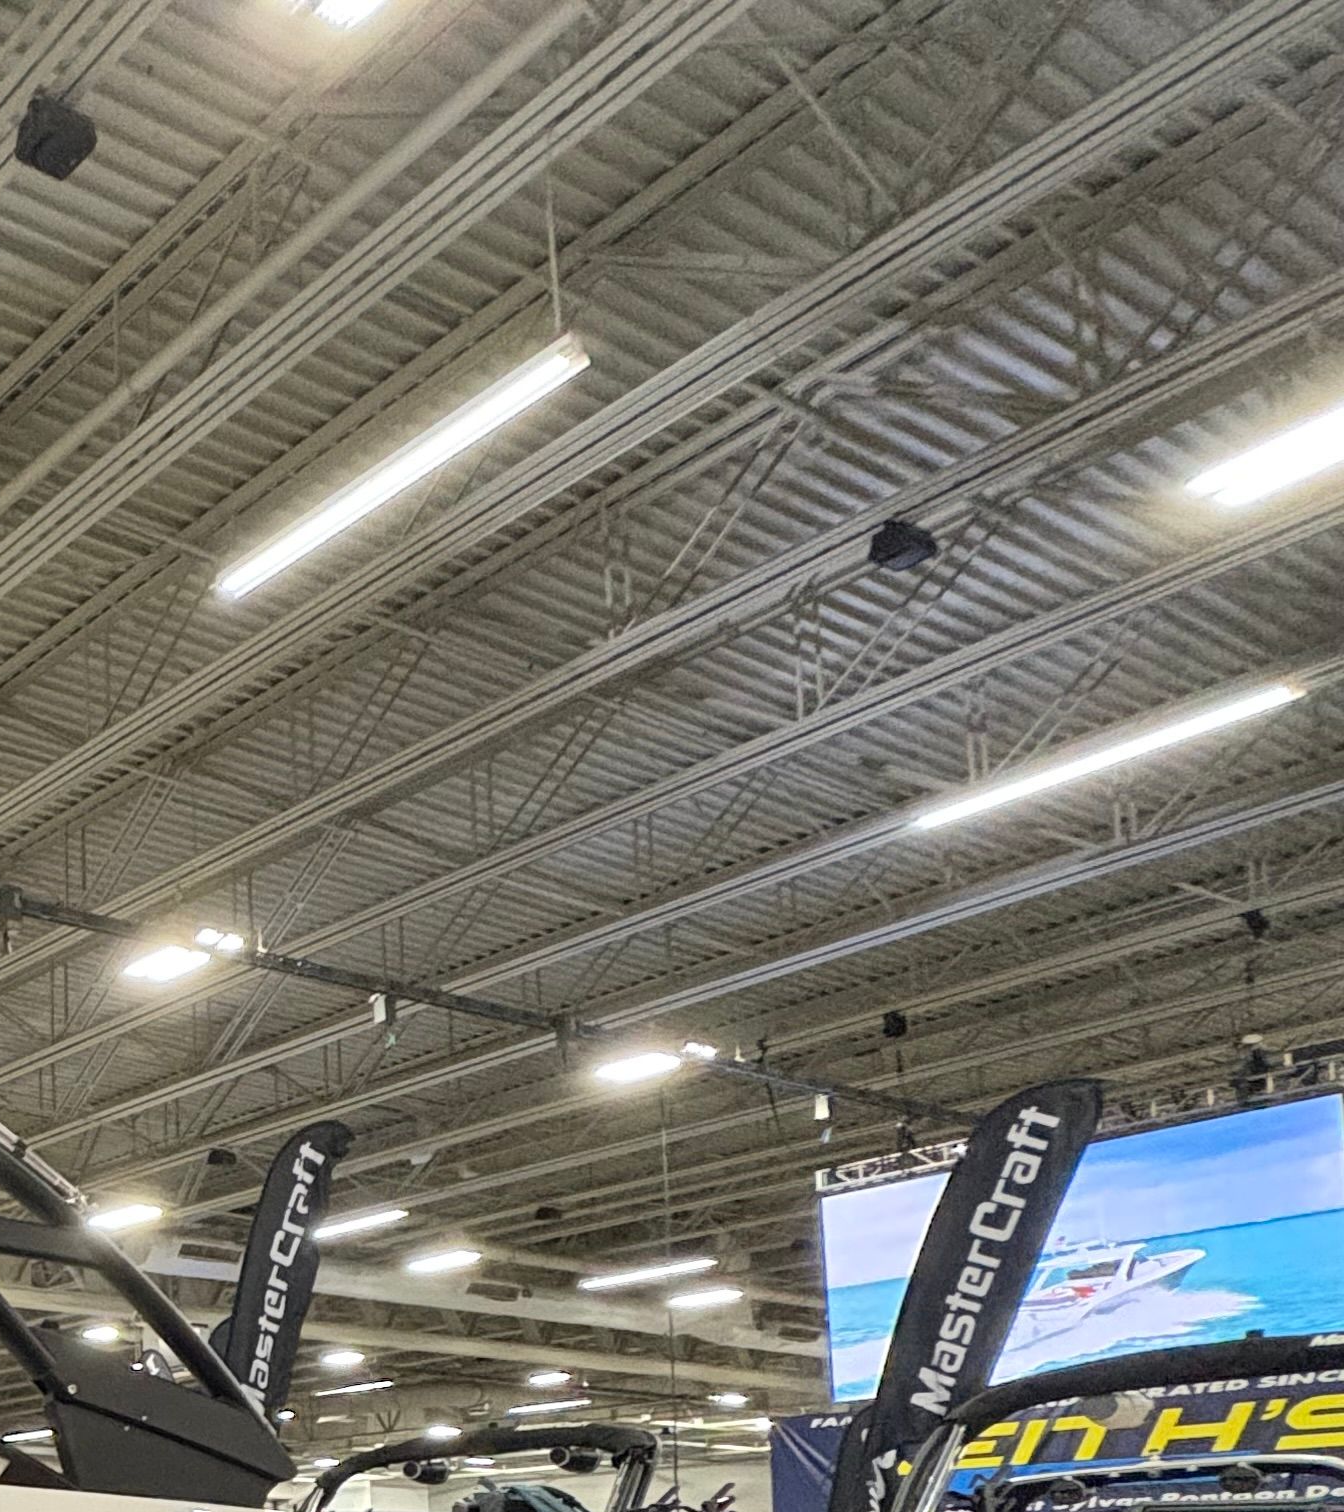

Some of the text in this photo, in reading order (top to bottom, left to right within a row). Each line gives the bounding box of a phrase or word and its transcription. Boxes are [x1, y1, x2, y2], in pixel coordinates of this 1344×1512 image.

[910, 1105, 1061, 1417] MasterCraft
[1256, 1369, 1344, 1389] SINC
[952, 1392, 1344, 1469] EITH'S
